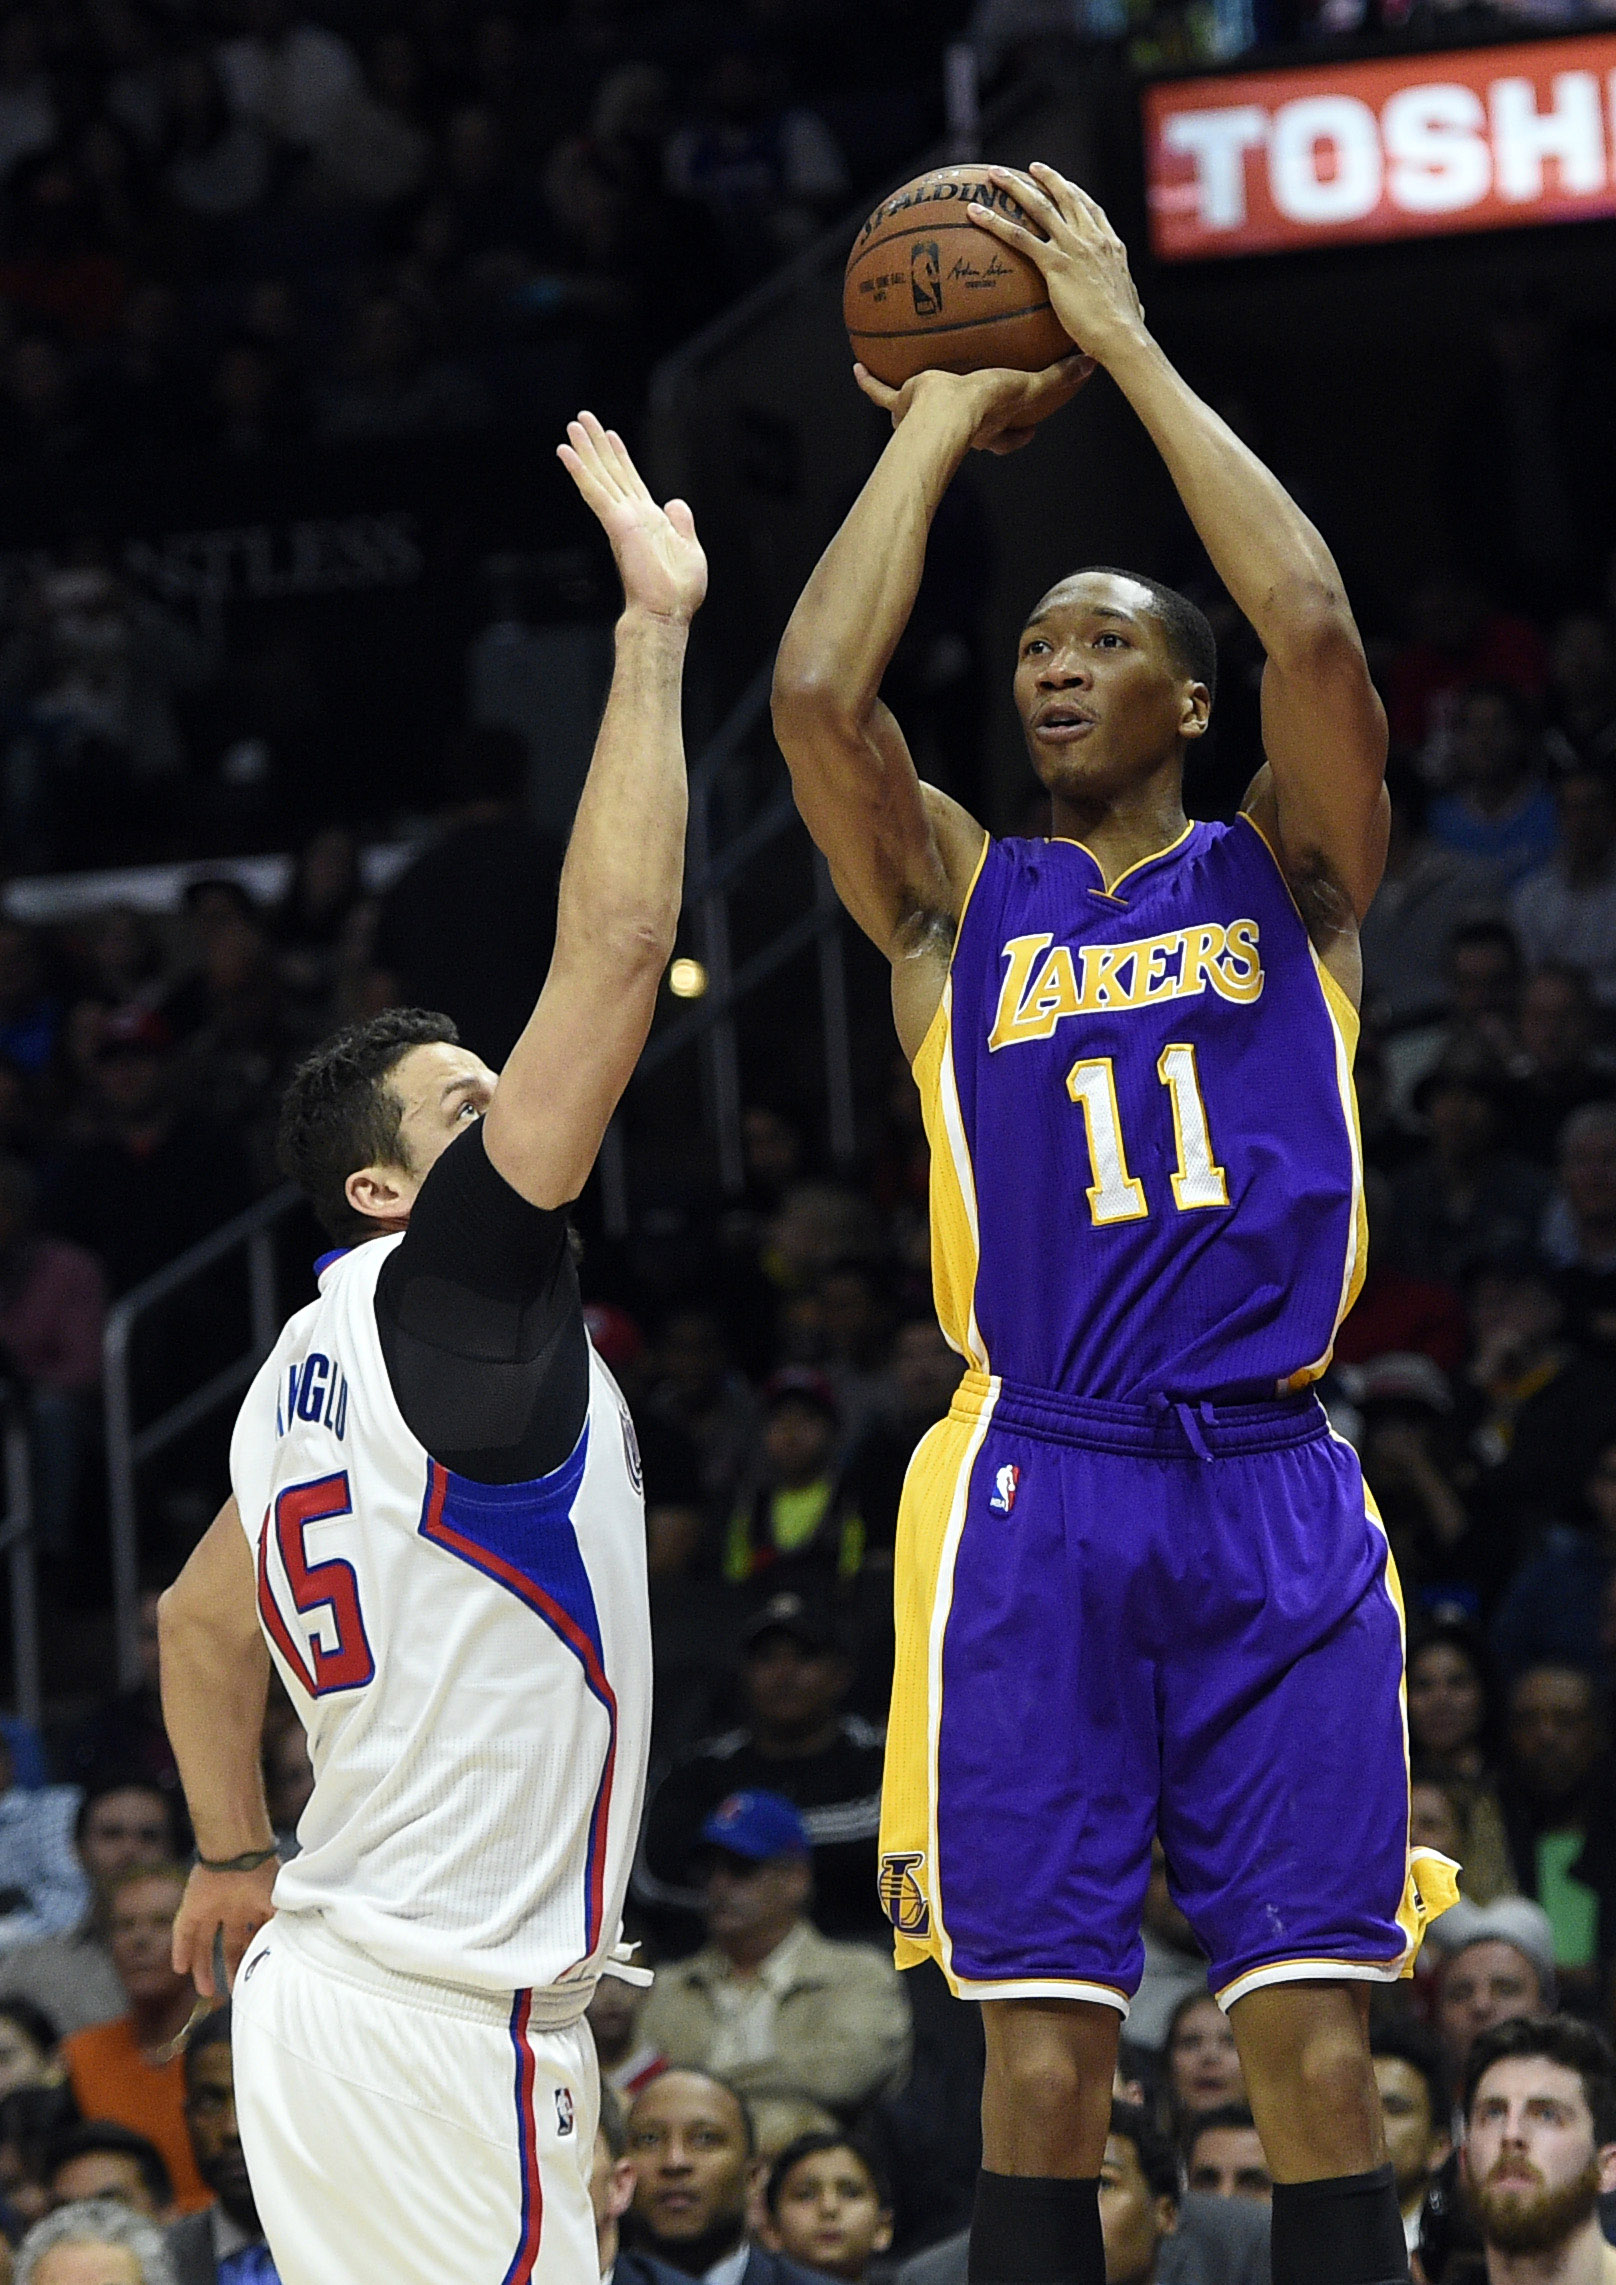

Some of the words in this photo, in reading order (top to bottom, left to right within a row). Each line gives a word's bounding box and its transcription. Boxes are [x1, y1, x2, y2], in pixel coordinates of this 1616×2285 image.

[1161, 70, 1616, 232] TOSH
[987, 919, 1265, 1053] LAKERS
[1066, 1043, 1231, 1227] 11
